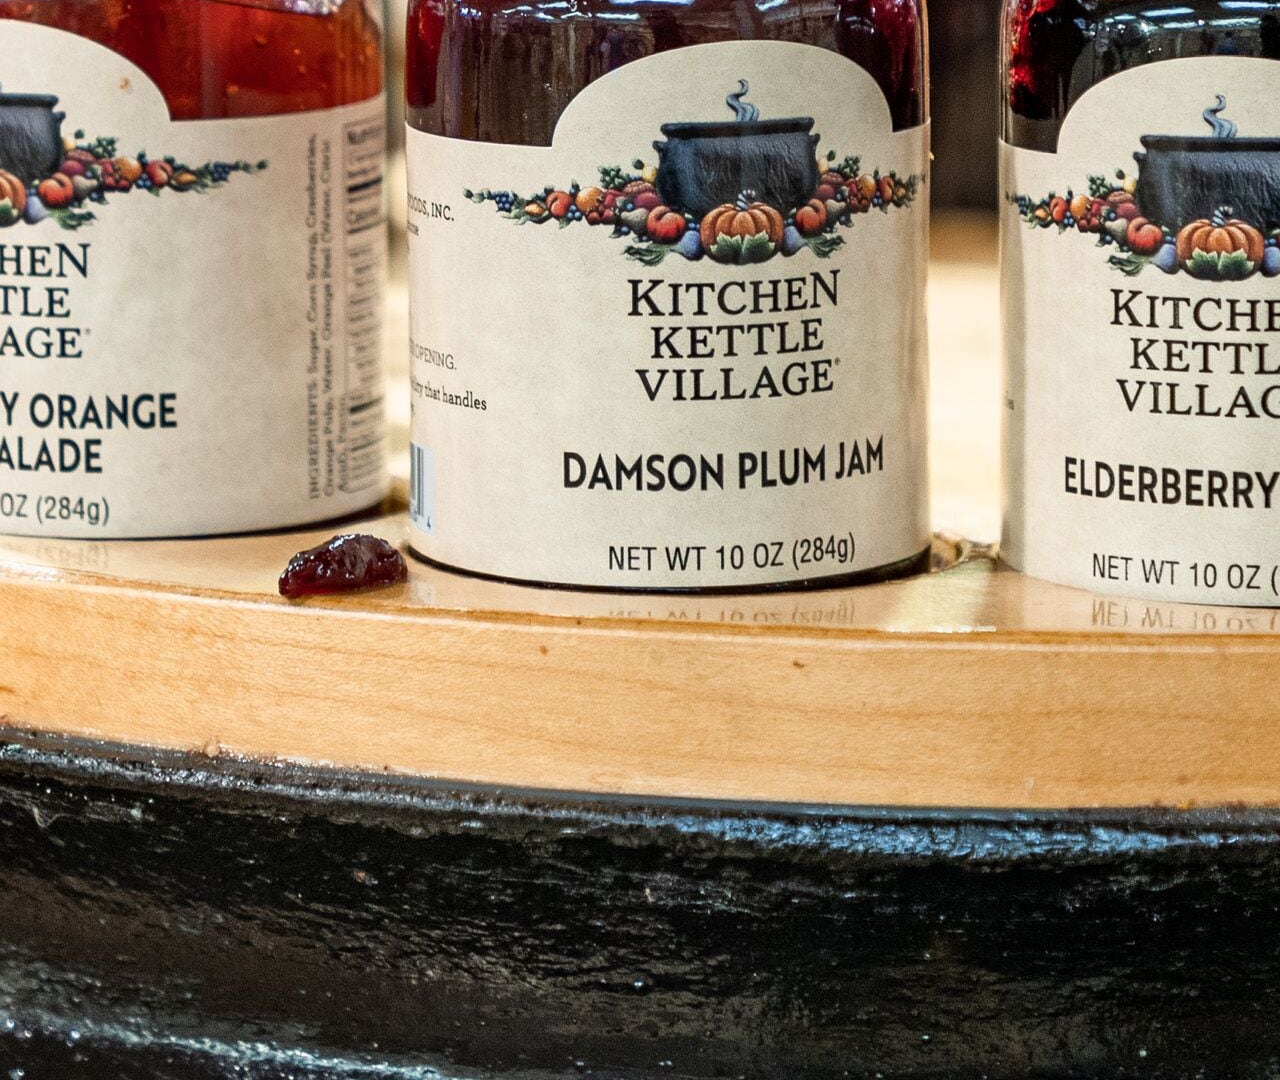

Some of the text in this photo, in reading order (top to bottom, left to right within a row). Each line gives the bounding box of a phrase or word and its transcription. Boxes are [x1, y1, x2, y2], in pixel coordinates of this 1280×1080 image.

[431, 202, 455, 221] INC.
[627, 269, 841, 317] KITCHEN
[650, 318, 824, 359] KETTLE
[29, 392, 178, 430] ORANGE
[424, 380, 441, 401] that
[442, 385, 487, 411] handles
[563, 435, 884, 492] DAMSON PLUM JAM
[1064, 455, 1280, 509] ELDERBERRY
[0, 493, 28, 519] OZ
[36, 495, 110, 527] (284g)
[609, 531, 856, 571] NET WT 10 OZ (284g)
[1092, 552, 1133, 581] NET
[1141, 558, 1180, 585] WT
[1190, 563, 1217, 588] 10
[1227, 564, 1261, 589] OZ
